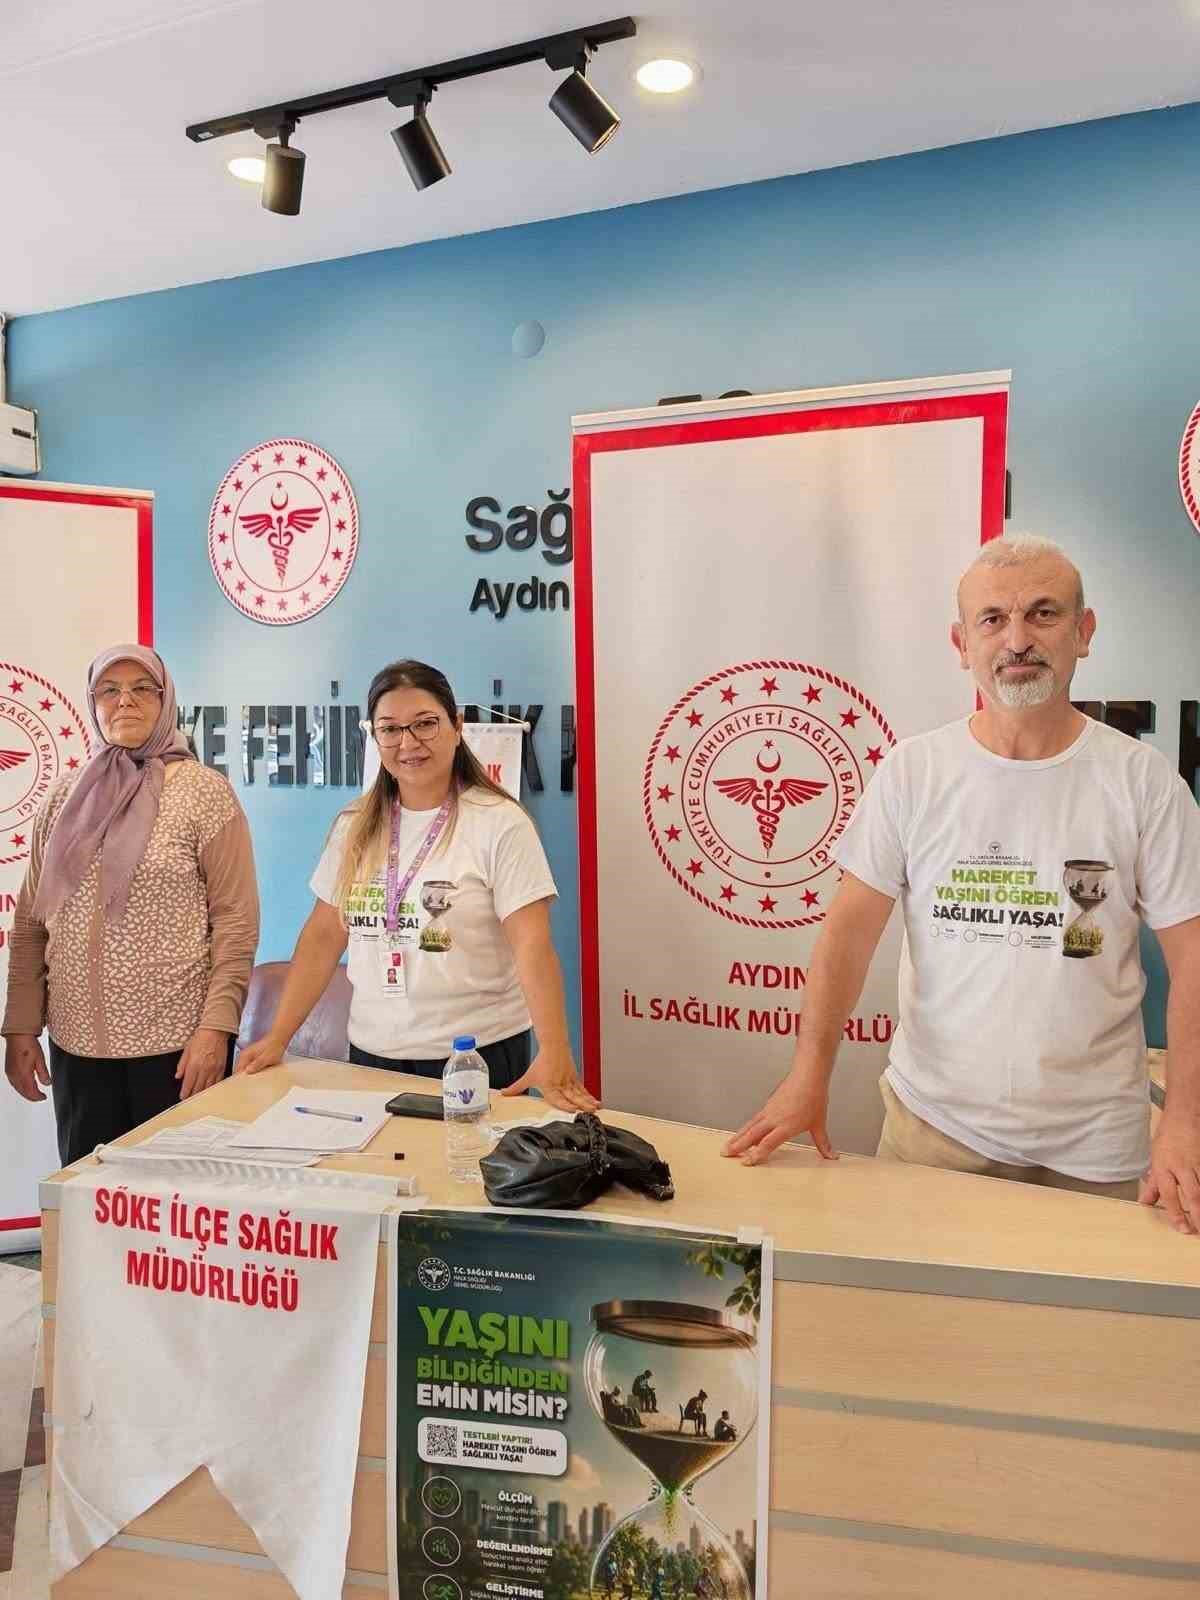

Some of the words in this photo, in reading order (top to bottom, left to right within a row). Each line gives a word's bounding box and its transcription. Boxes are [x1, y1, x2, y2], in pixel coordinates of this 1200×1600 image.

[469, 575, 570, 620] Aydın
[688, 710, 783, 791] CUMHURİYETİ
[788, 716, 847, 766] SAĞLIK
[689, 796, 733, 867] TÜRKİYE
[952, 869, 1037, 885] HAREKET
[936, 886, 990, 904] YAŞINI
[994, 885, 1059, 906] ÖĞREN
[933, 903, 1004, 925] SAĞLIKLI
[1008, 910, 1064, 929] YAŞA!
[623, 989, 643, 1018] İL
[650, 996, 741, 1031] SAĞLIK
[95, 1186, 161, 1233] SÖKE
[170, 1193, 229, 1251] İLÇE
[238, 1210, 338, 1260] SAĞLIK
[126, 1247, 299, 1312] MÜDÜRLÜĞÜ
[467, 1267, 493, 1278] SAĞLIK
[495, 1270, 536, 1281] BAKANLIĞI
[417, 1305, 569, 1359] YAŞINI
[416, 1355, 569, 1392] BİLDİĞİNDEN
[416, 1382, 478, 1411] EMİN
[484, 1387, 568, 1420] MİSİN?
[463, 1430, 500, 1442] TESTLERİ
[463, 1440, 500, 1451] HAREKET
[501, 1444, 527, 1455] YAŞINI
[528, 1445, 557, 1457] ÖĞREN
[463, 1449, 498, 1461] SAĞLIKLI
[499, 1452, 523, 1463] YAŞA!
[498, 1490, 533, 1504] ÖLÇÜM
[476, 1539, 553, 1557] DEĞERLENDİRME
[485, 1582, 544, 1598] GELİŞTİRME
